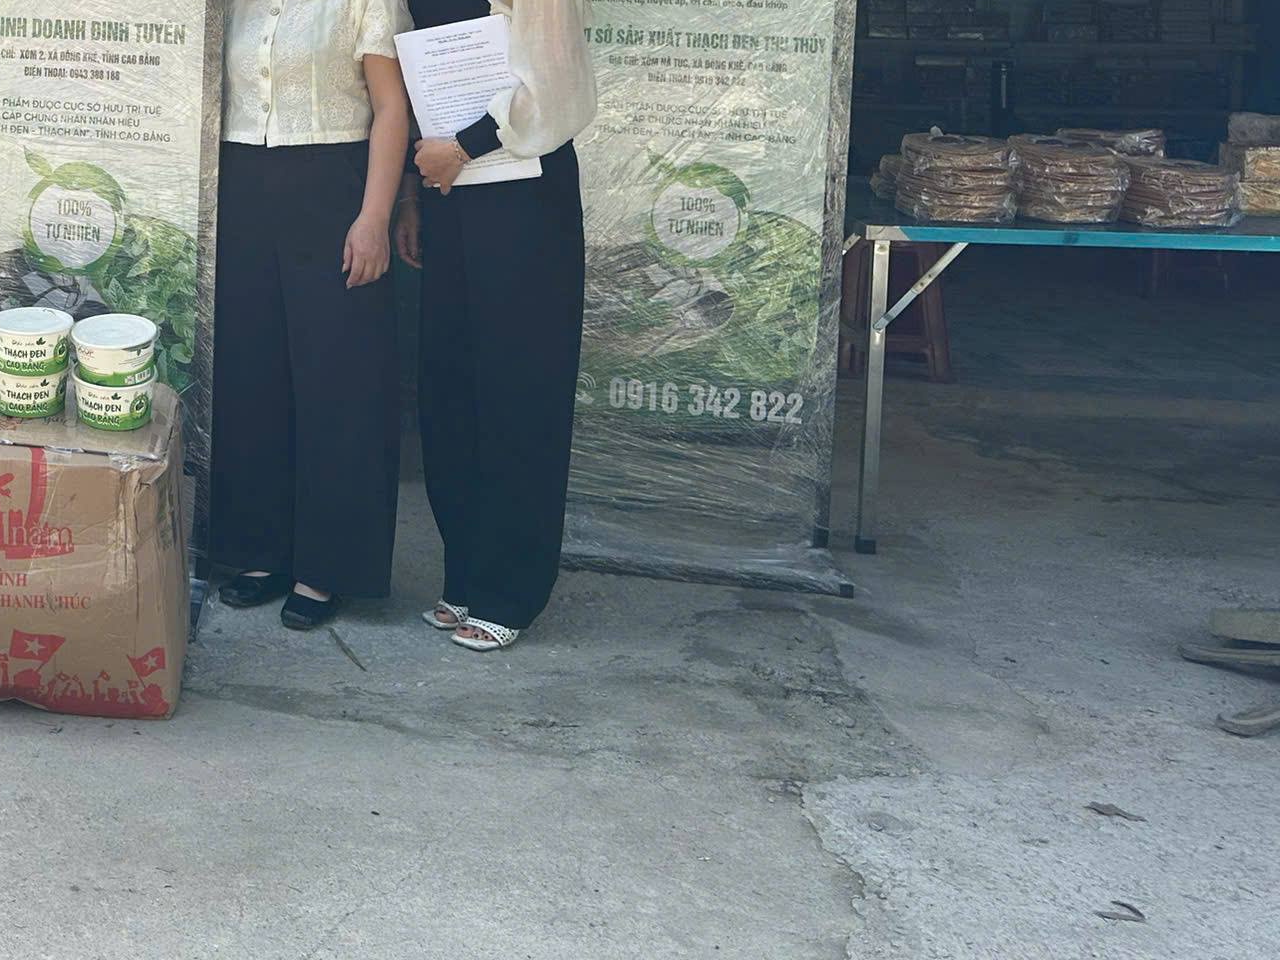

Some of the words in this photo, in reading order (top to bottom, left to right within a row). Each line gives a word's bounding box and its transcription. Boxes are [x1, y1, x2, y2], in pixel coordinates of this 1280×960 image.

[31, 18, 86, 41] DOANH
[56, 199, 92, 217] 100%
[680, 196, 715, 213] 100%
[609, 377, 678, 414] 0916
[688, 384, 741, 419] 342
[749, 390, 805, 424] 822
